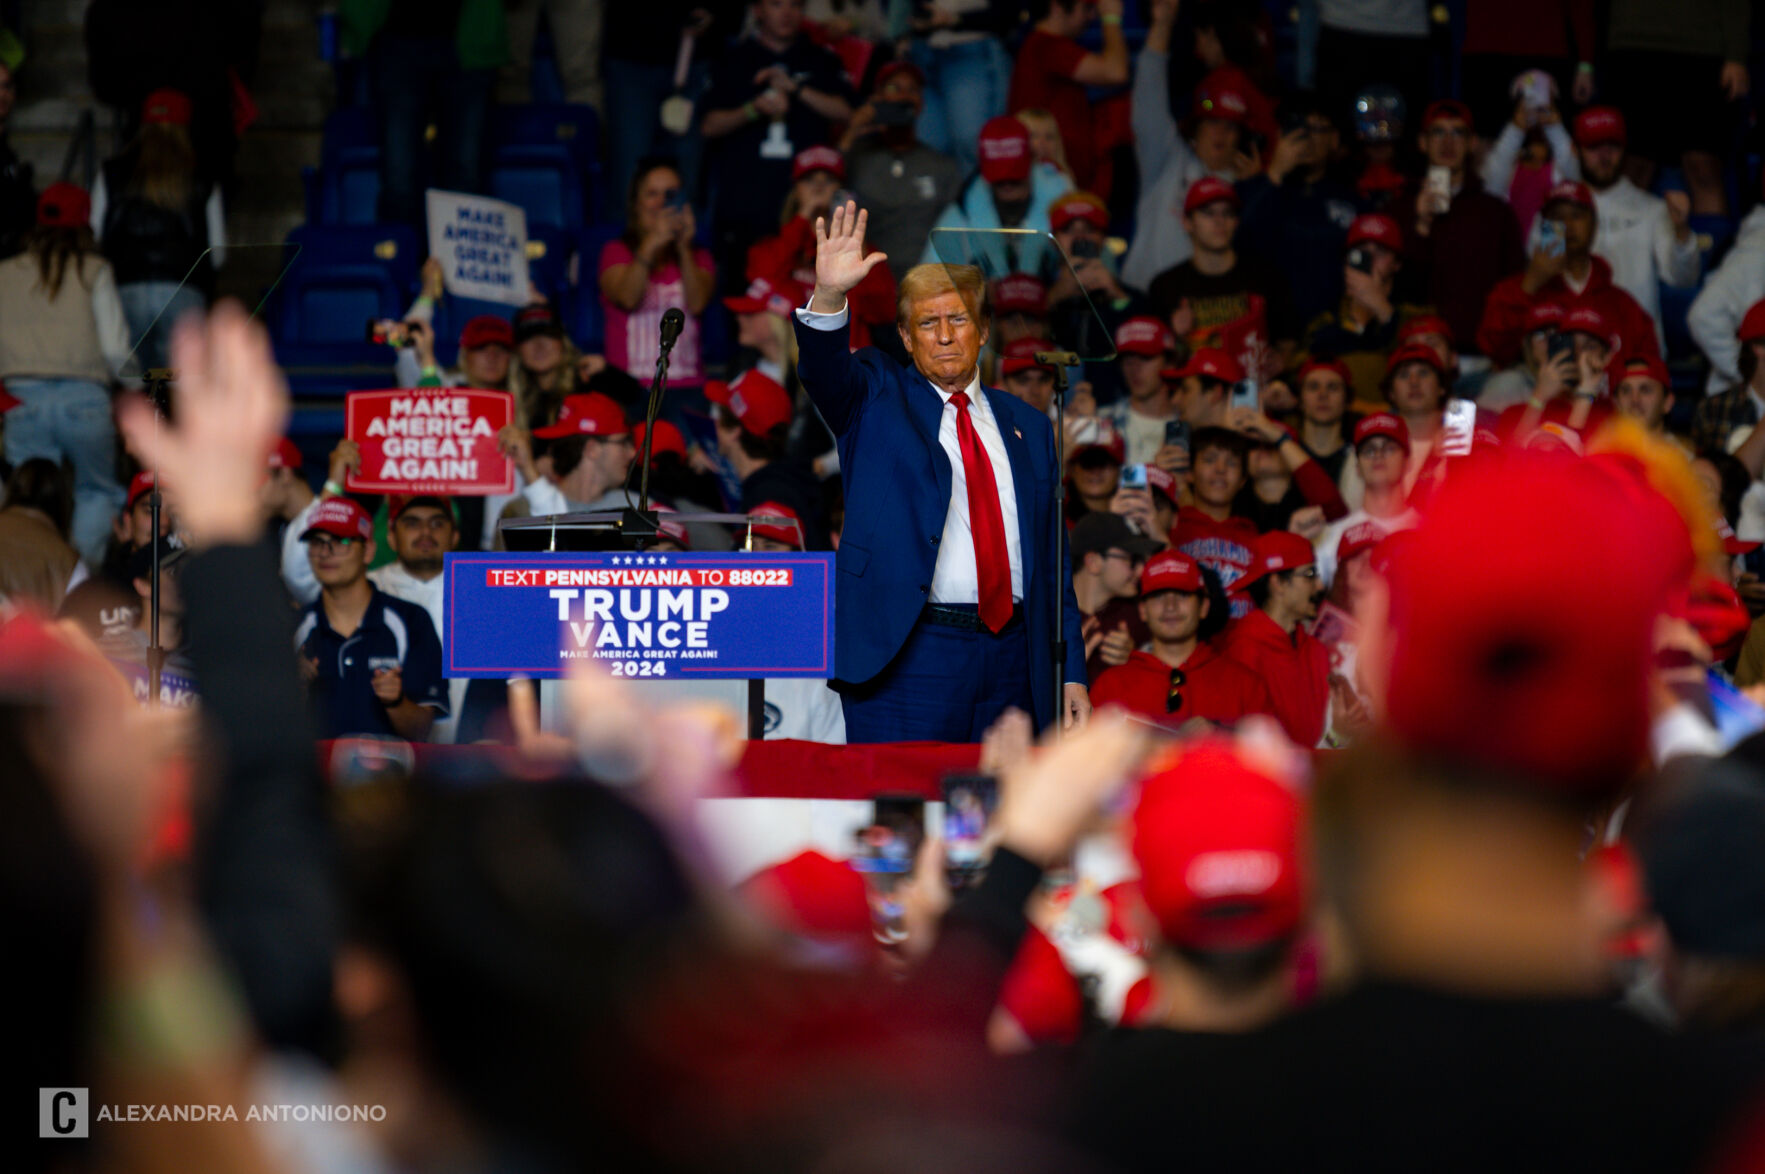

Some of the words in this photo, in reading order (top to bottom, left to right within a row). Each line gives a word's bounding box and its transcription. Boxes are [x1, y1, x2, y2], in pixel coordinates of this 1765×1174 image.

[457, 206, 504, 227] MAKE
[444, 223, 518, 250] AMERICA
[454, 245, 511, 266] GREAT
[390, 397, 469, 416] MAKE
[366, 416, 492, 437] AMERICA
[382, 437, 477, 458] GREAT
[379, 458, 478, 480] AGAIN!
[491, 570, 540, 585] TEXT
[545, 570, 692, 585] PENNSYLVANIA
[698, 570, 724, 585] TO
[729, 570, 788, 585] 88022
[549, 589, 730, 621] TRUMP
[570, 622, 708, 648] VANCE
[559, 650, 589, 659] MAKE
[592, 650, 640, 659] AMERICA
[643, 650, 677, 659] GREAT
[680, 650, 718, 659] AGAIN!
[611, 661, 666, 676] 2024
